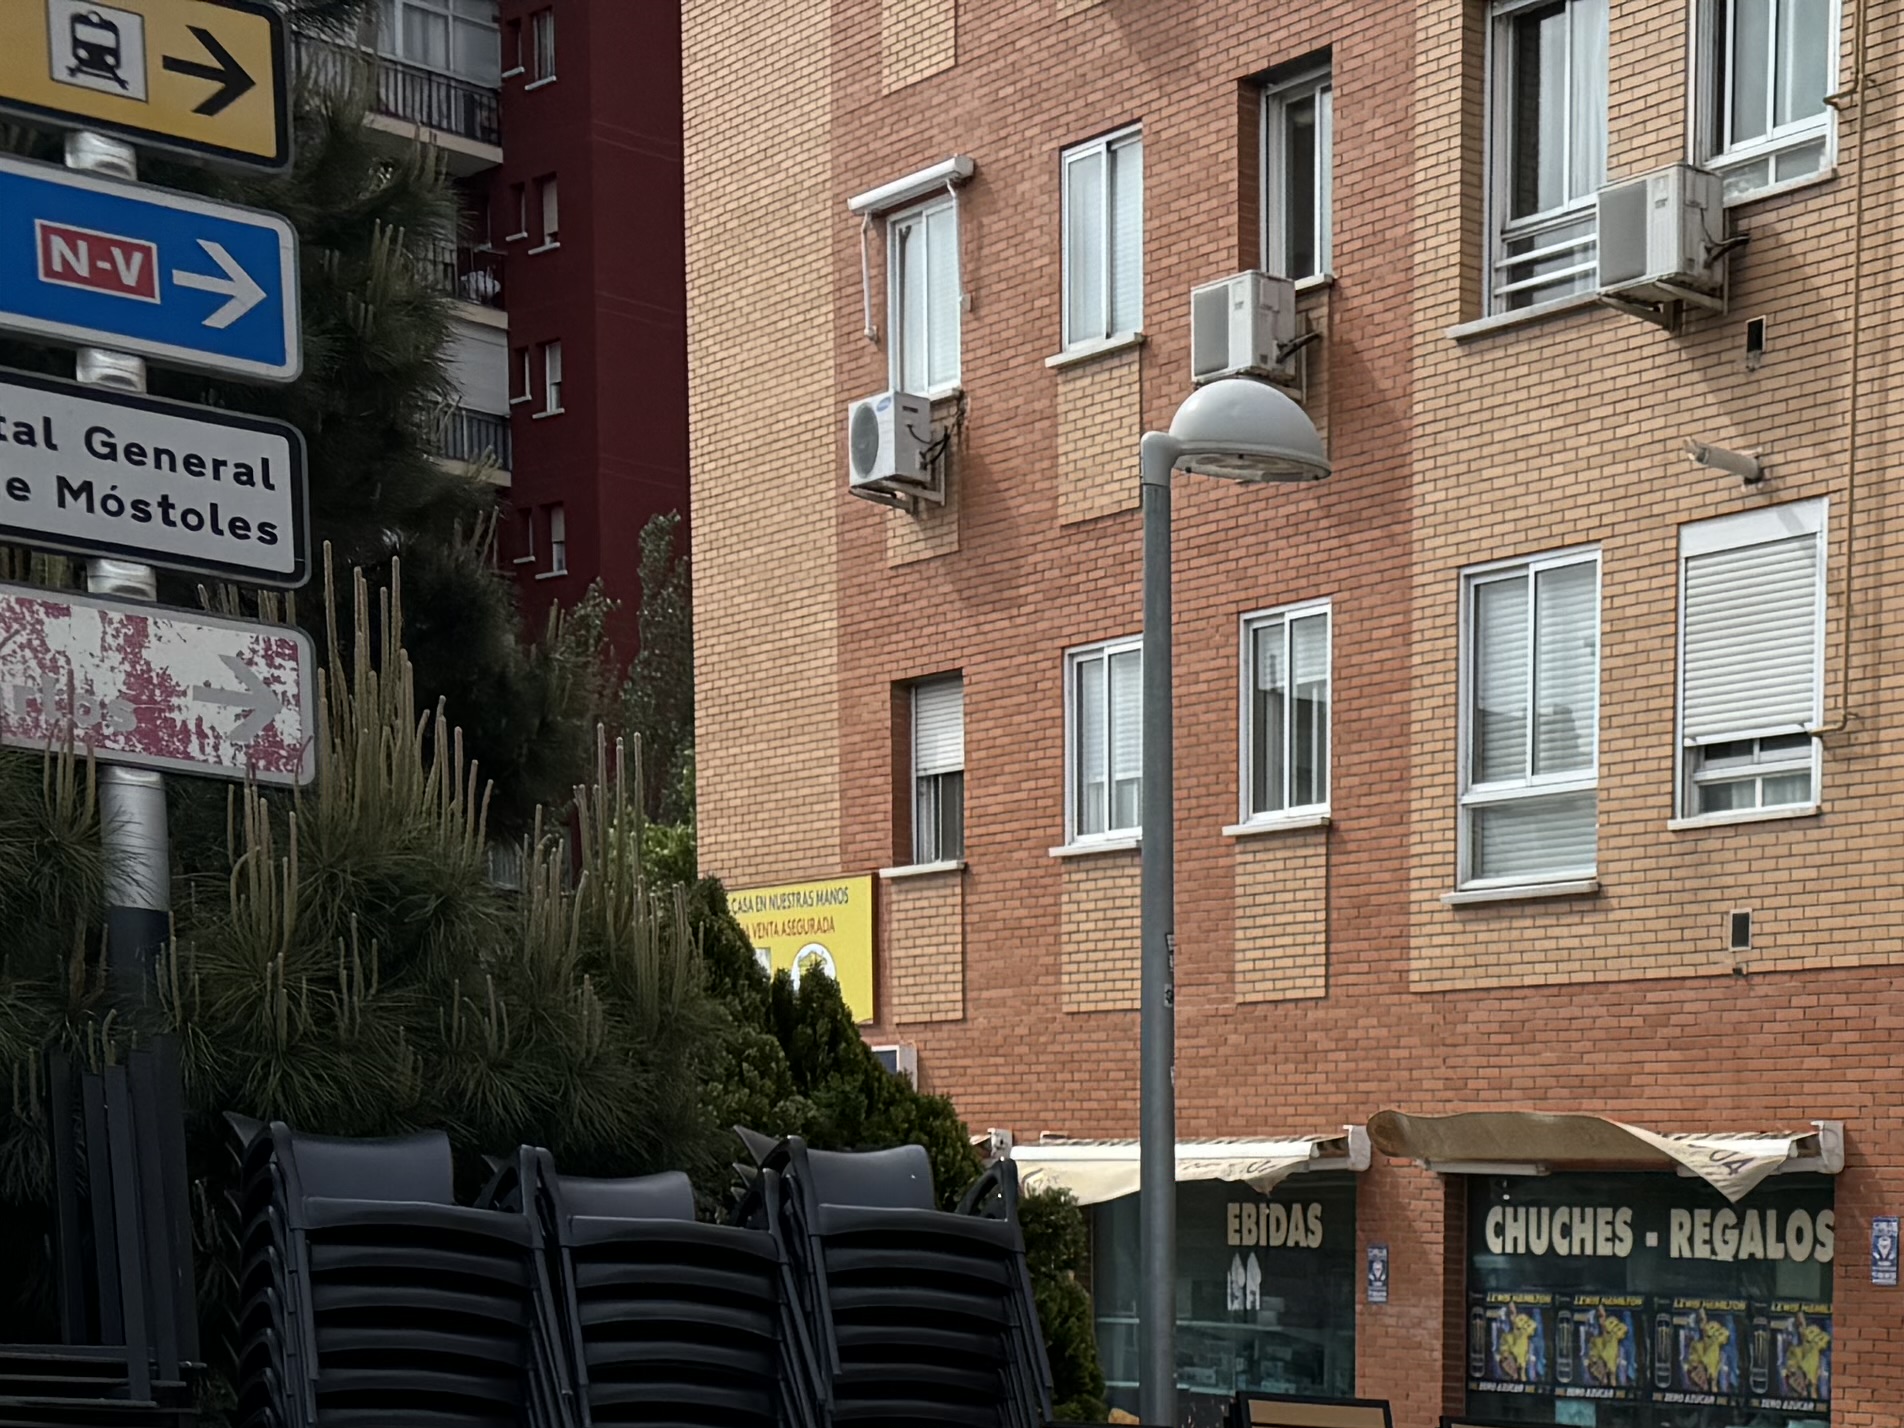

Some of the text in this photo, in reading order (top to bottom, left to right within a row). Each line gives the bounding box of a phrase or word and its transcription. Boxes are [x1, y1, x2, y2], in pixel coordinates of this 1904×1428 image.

[49, 233, 145, 289] N-V
[84, 426, 276, 491] General
[56, 475, 279, 546] Móstoles
[752, 920, 779, 939] VENTA
[781, 915, 836, 938] ASEGURADA
[755, 895, 767, 913] EN
[768, 889, 814, 911] NUESTRAS
[816, 886, 849, 908] MANOS
[1226, 1202, 1323, 1249] EBIDAS
[1485, 1205, 1634, 1258] CHUCHES
[1670, 1207, 1835, 1264] REGALOS
